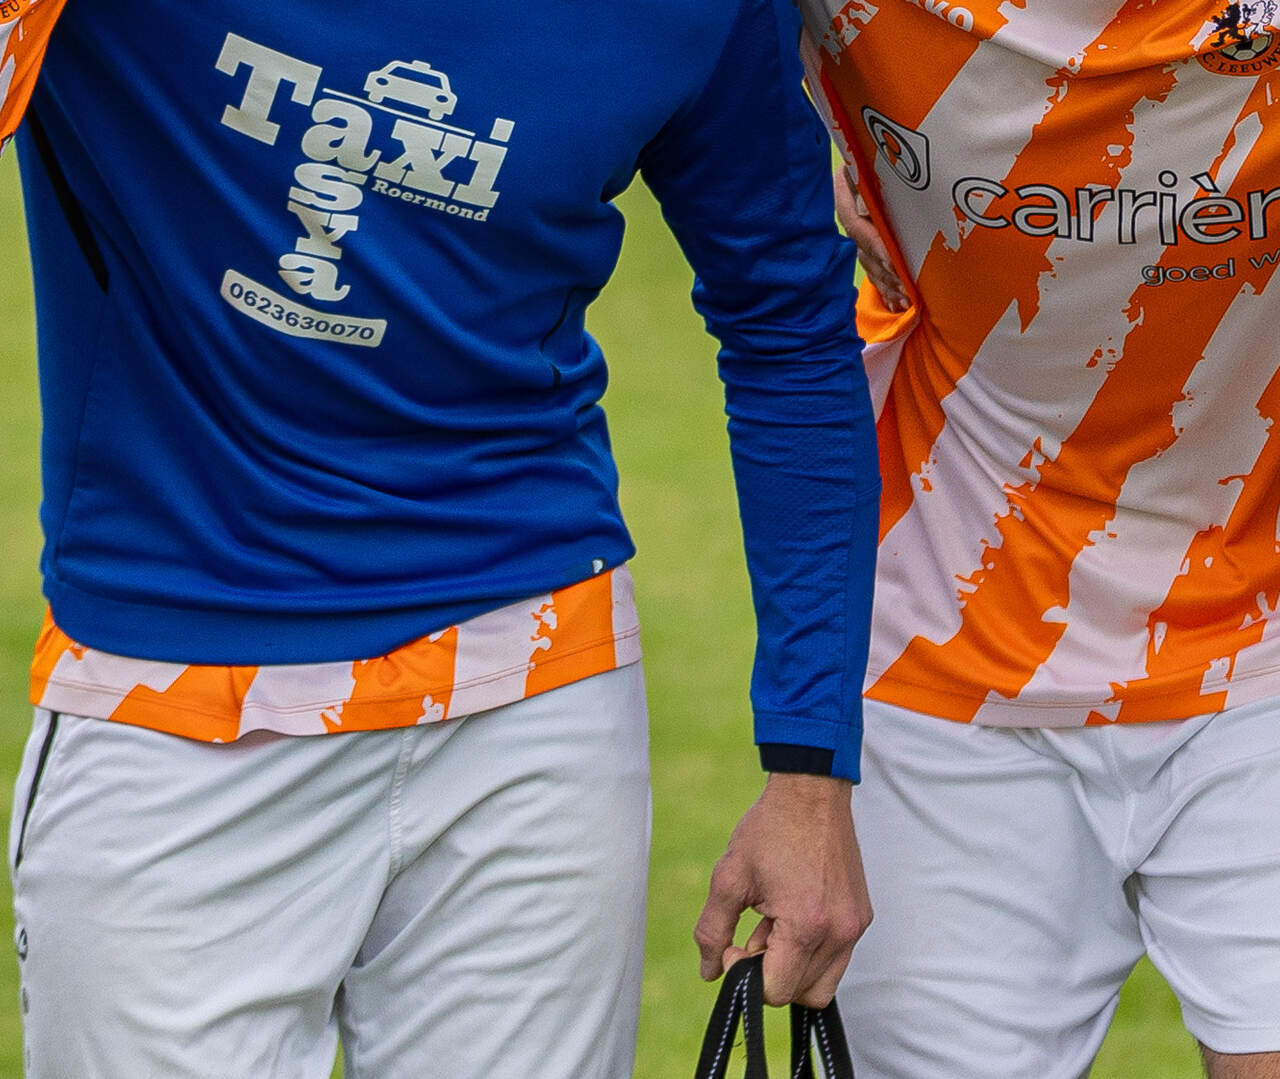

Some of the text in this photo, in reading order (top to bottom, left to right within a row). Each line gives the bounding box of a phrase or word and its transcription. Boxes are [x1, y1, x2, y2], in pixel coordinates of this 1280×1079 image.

[214, 31, 516, 210] Taxi
[371, 178, 491, 223] Roermond
[1141, 257, 1236, 287] goed
[229, 281, 376, 341] 0623630070
